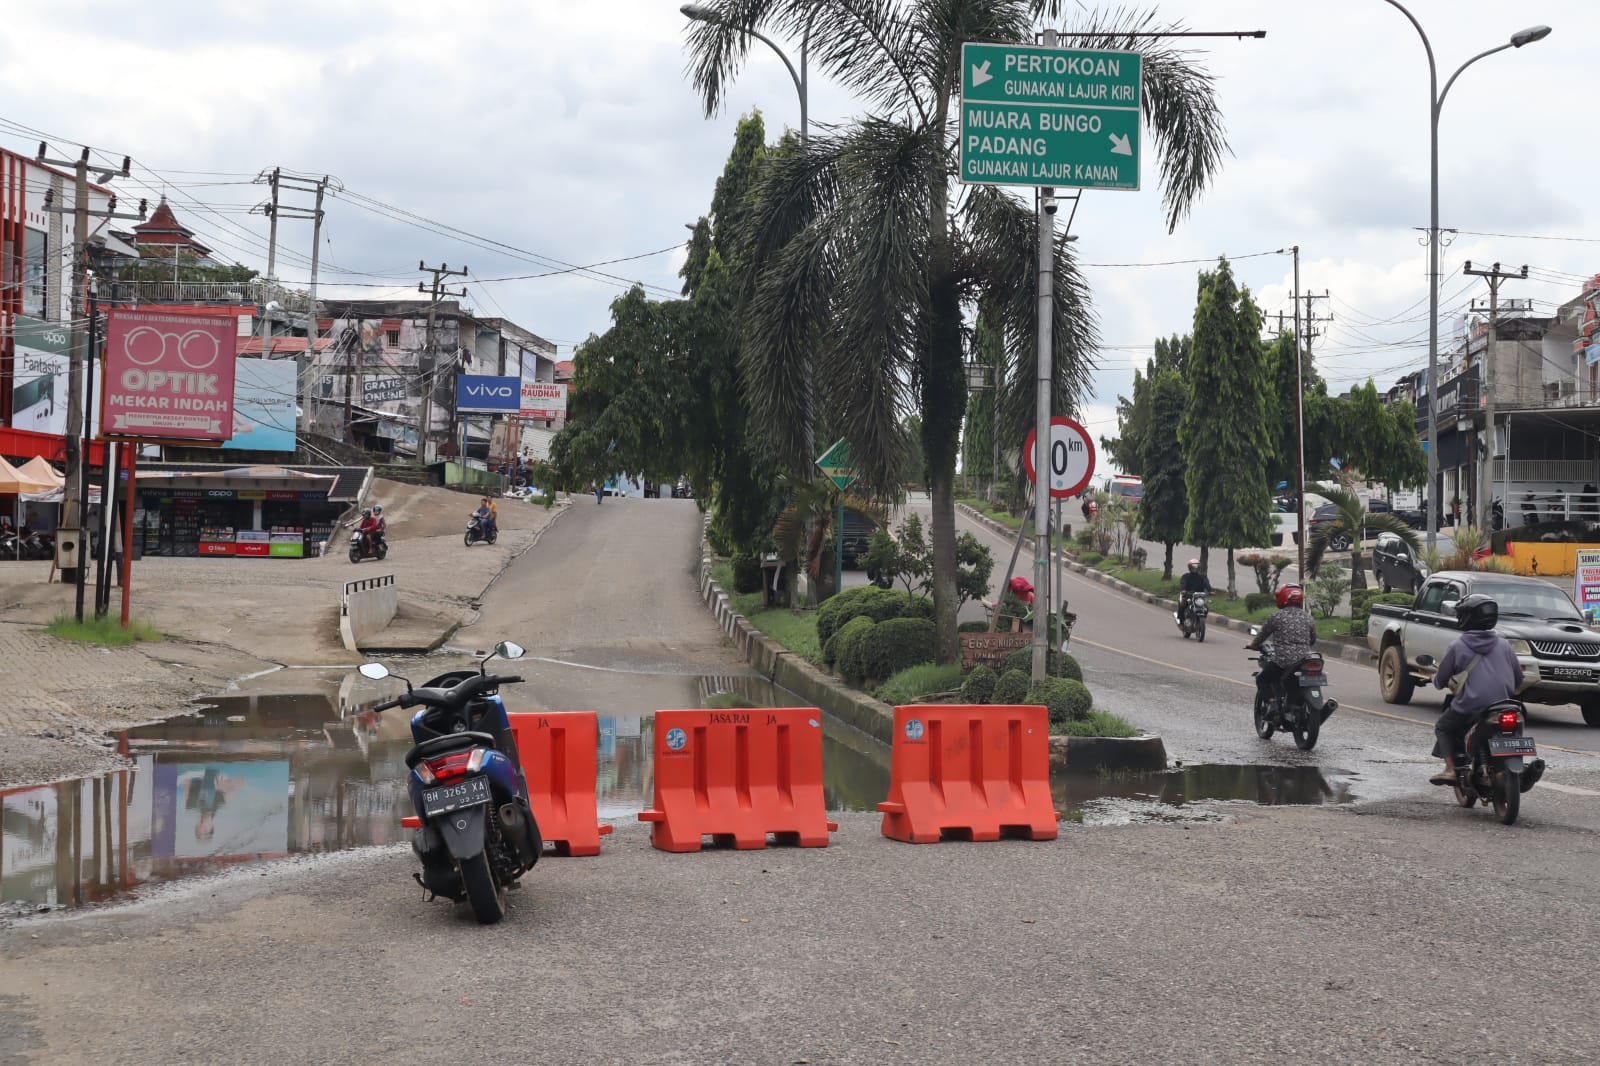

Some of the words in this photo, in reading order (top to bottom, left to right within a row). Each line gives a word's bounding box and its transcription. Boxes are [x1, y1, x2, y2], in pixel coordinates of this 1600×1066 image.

[1005, 54, 1120, 77] PERTOKOAN
[1004, 79, 1065, 97] GUNAKAN
[1069, 83, 1107, 100] LAJUR
[1111, 85, 1135, 100] KIRI
[968, 110, 1032, 130] MUARA
[1039, 113, 1102, 133] BUNGO
[968, 136, 1047, 156] PADANG
[968, 159, 1028, 177] GUNAKAN
[1032, 163, 1071, 179] LAJUR
[1075, 164, 1118, 181] KANAN
[24, 353, 62, 376] Fantastic
[121, 368, 218, 395] OPTIK
[365, 380, 400, 391] GRATIS
[466, 384, 512, 396] vivo
[364, 390, 405, 402] ONLINE
[521, 389, 560, 398] RAUDHAH
[110, 394, 170, 408] MEKAR
[174, 398, 228, 412] INDAH
[1068, 438, 1082, 452] km
[1581, 555, 1600, 563] SERVIC
[538, 718, 549, 729] JA
[709, 714, 731, 724] JASA
[426, 791, 439, 802] BH
[443, 785, 467, 798] 3265
[472, 781, 485, 792] XA
